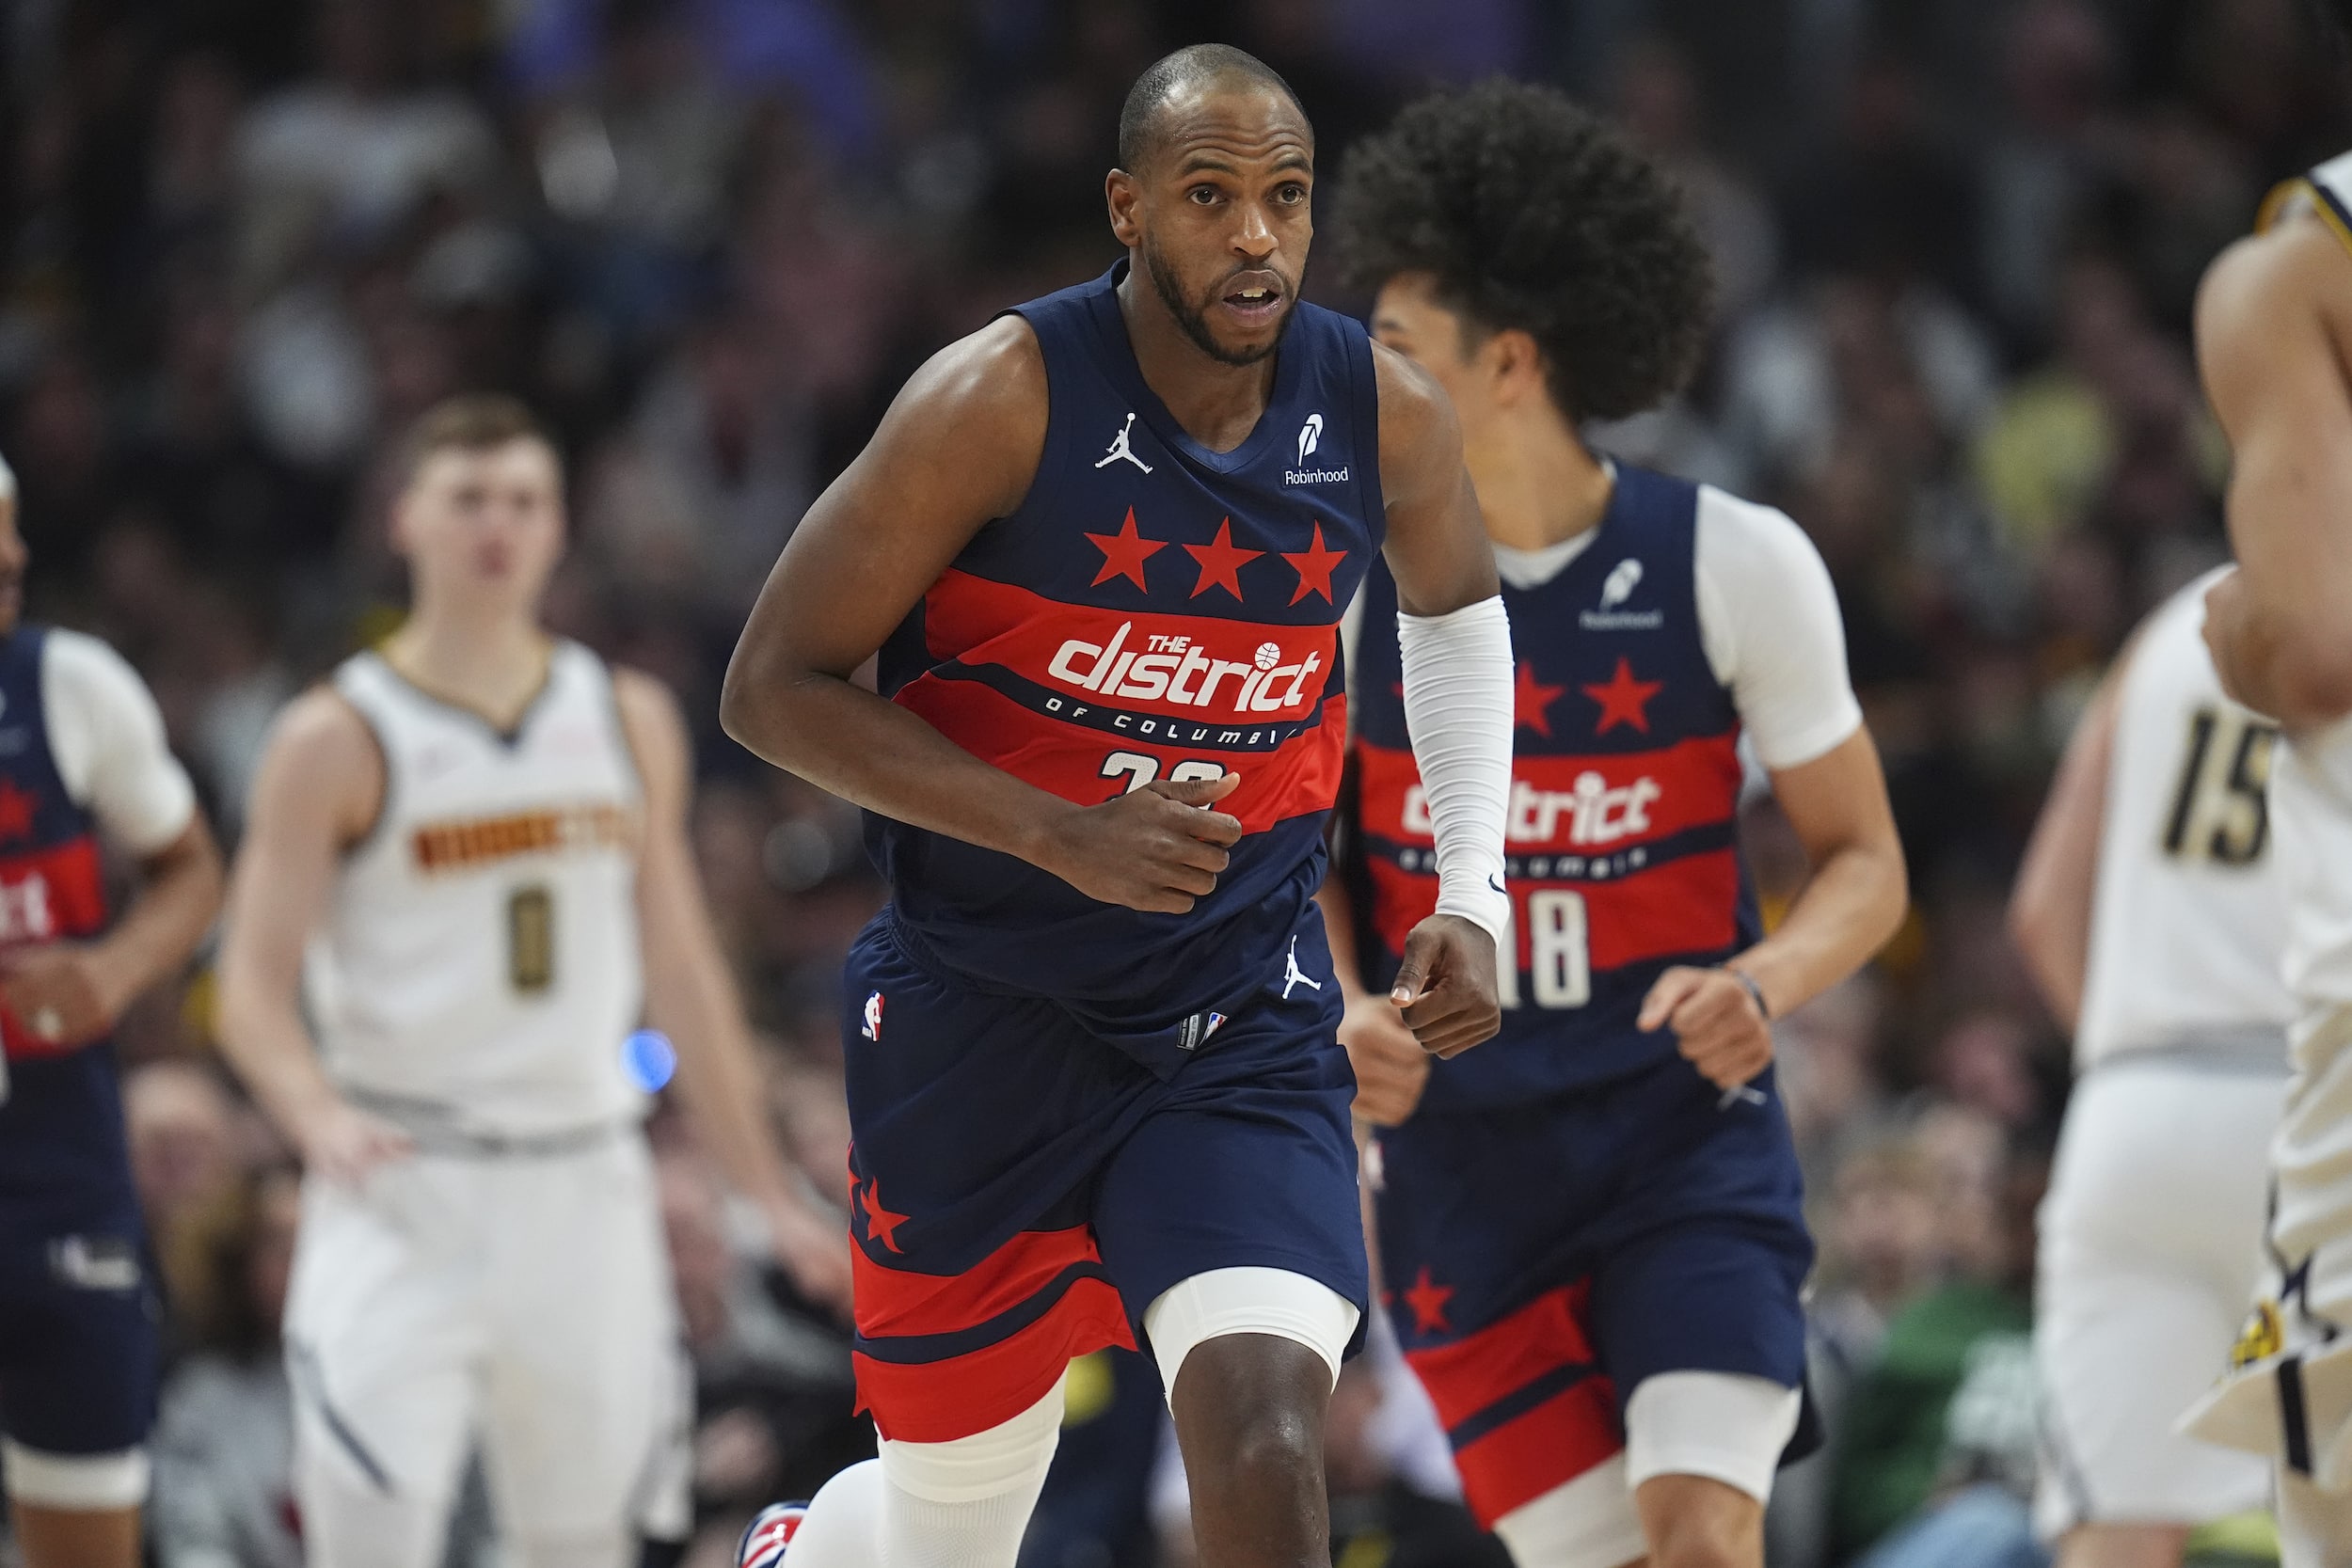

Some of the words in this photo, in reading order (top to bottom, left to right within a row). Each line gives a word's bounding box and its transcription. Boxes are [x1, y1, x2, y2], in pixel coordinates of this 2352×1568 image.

[1285, 466, 1349, 485] Robinhood
[1047, 621, 1321, 712] district
[1148, 635, 1191, 653] THE
[1045, 697, 1088, 718] OF
[1114, 714, 1297, 745] COLUMBI
[2166, 704, 2280, 863] 15
[508, 884, 555, 994] 0
